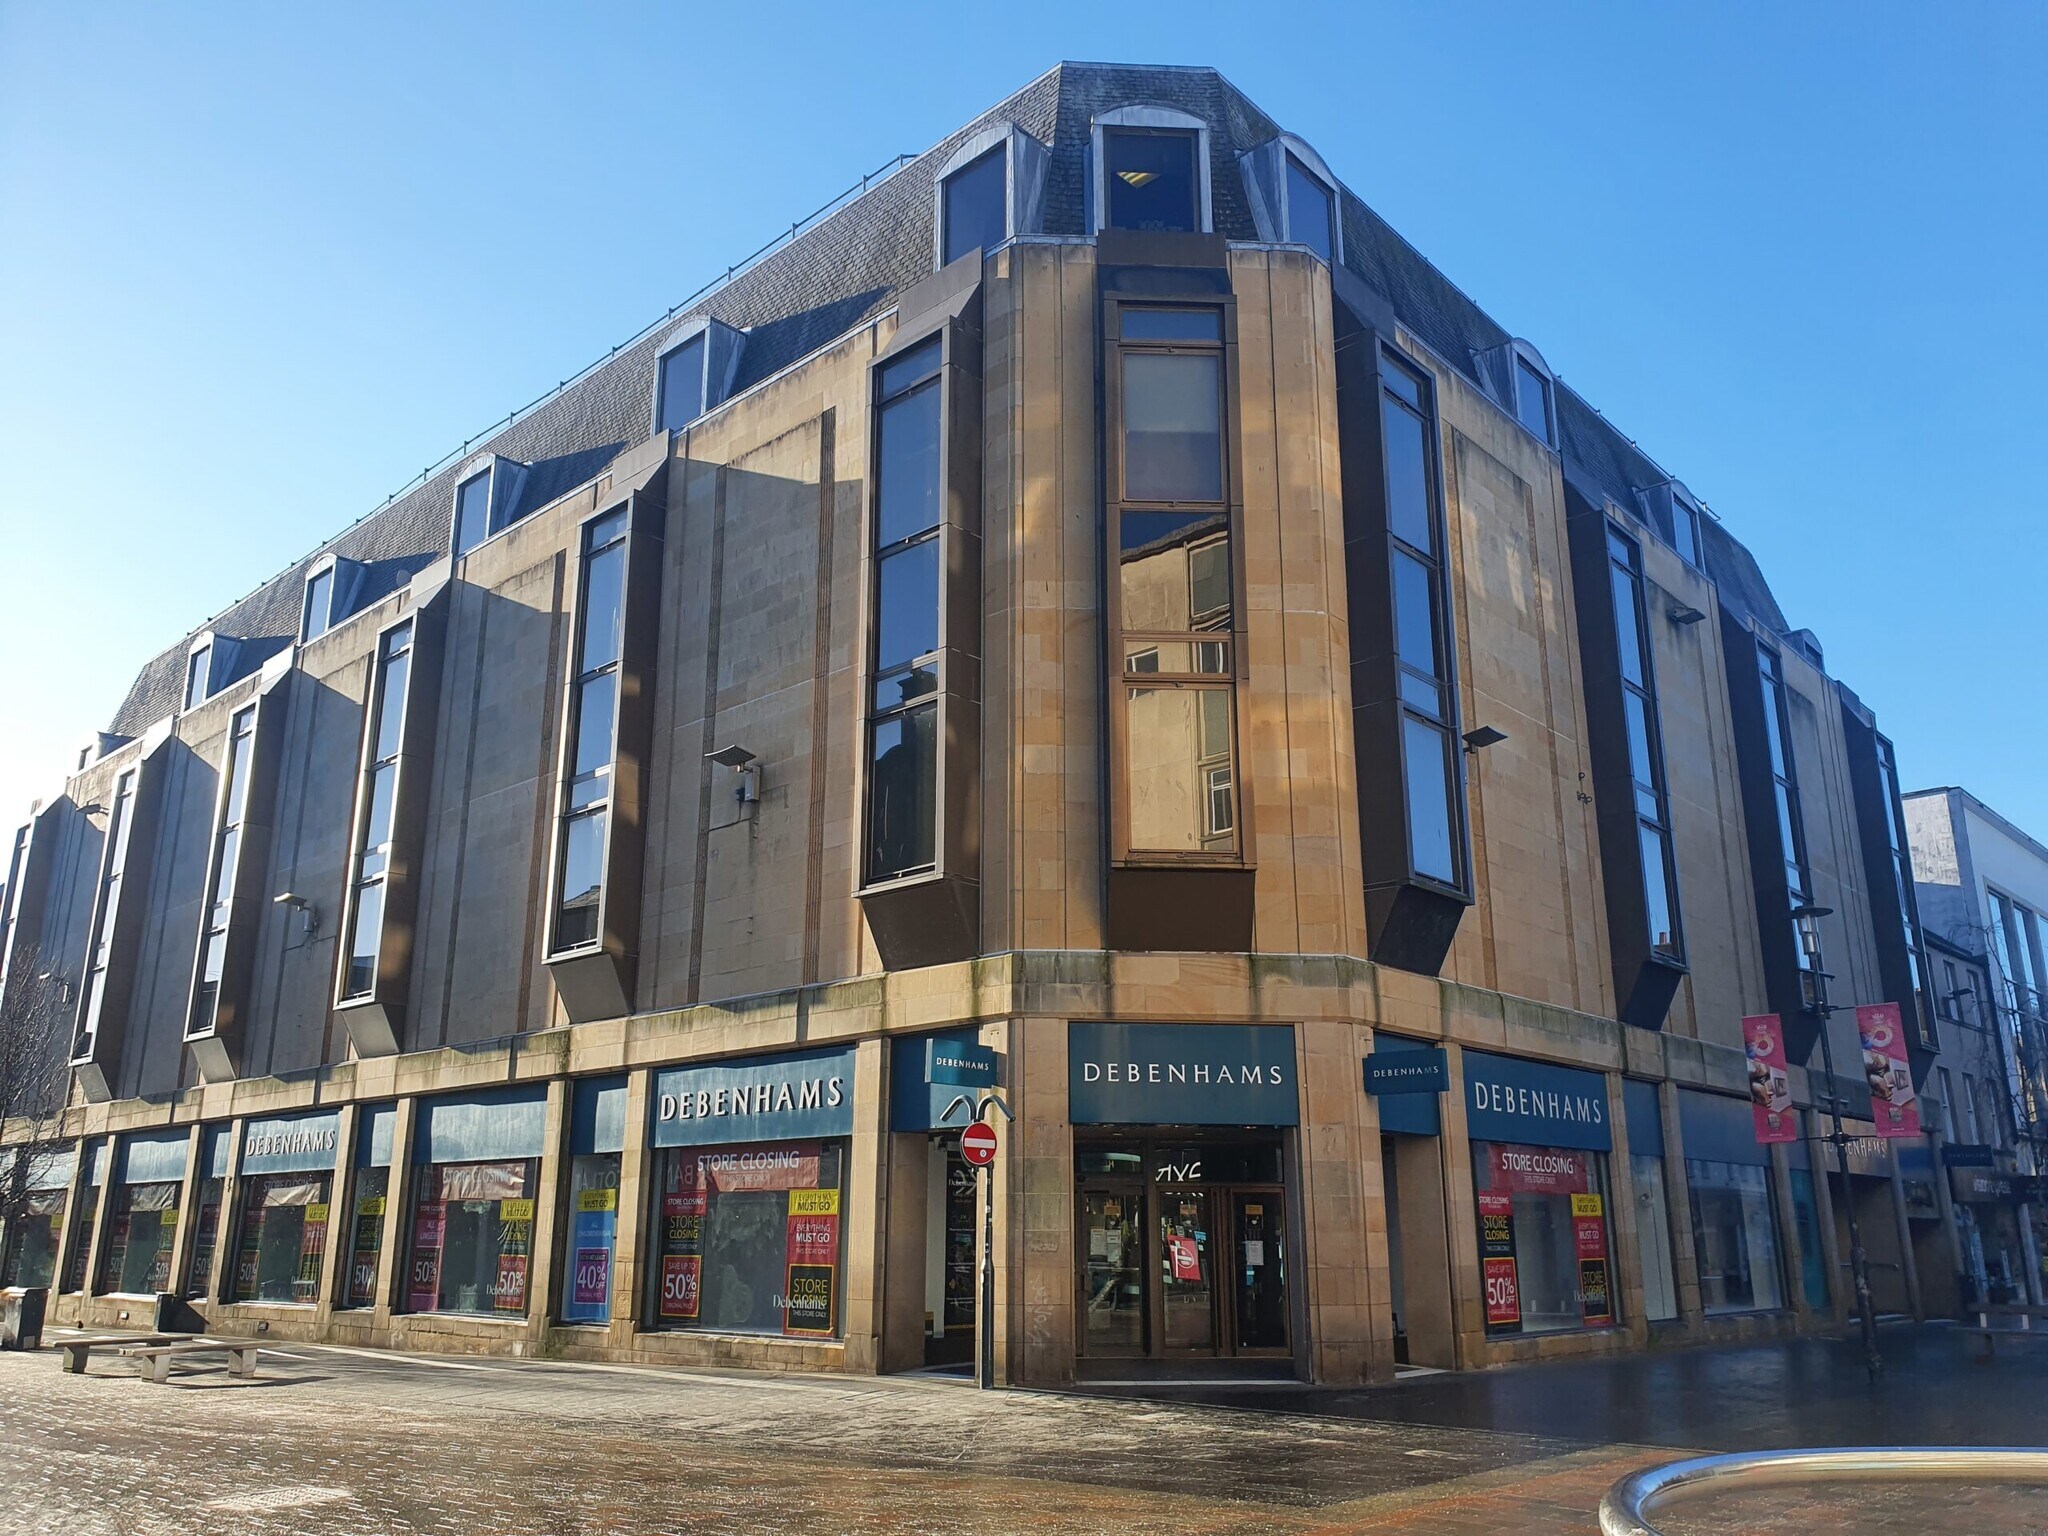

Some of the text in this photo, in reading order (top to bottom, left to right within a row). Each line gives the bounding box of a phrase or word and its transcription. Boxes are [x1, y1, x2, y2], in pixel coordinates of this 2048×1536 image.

[936, 1057, 989, 1071] DEBENHAMS
[1084, 1062, 1282, 1085] DEBENHAMS
[1374, 1065, 1439, 1078] DEBENHAMS
[660, 1076, 843, 1121] DEBENHAMS
[1475, 1082, 1601, 1124] DEBENHAMS
[247, 1129, 336, 1156] DEBENHAMS
[697, 1150, 799, 1171] STORE CLOSING
[1502, 1153, 1573, 1173] STORE CLOSING
[584, 1199, 608, 1208] MUST GO
[683, 1197, 703, 1205] CLOSING
[798, 1201, 830, 1211] MUST GO
[1478, 1196, 1491, 1204] STORE
[1577, 1204, 1597, 1212] MUST GO
[671, 1215, 699, 1229] STORE
[797, 1223, 831, 1231] EVERYTHING
[1484, 1215, 1508, 1229] STORE
[670, 1229, 698, 1239] CLOSING
[796, 1232, 830, 1242] MUST GO
[1485, 1230, 1509, 1240] CLOSING
[1579, 1230, 1600, 1239] MUST GO
[415, 1261, 437, 1282] 50%
[577, 1265, 606, 1289] 40%
[1583, 1271, 1604, 1284] STORE
[596, 1281, 605, 1289] OFF
[665, 1273, 697, 1299] 50%
[794, 1278, 828, 1294] STORE
[1488, 1277, 1514, 1305] 50%
[685, 1291, 697, 1299] OFF
[773, 1294, 827, 1309] Debenhams
[793, 1293, 828, 1306] CLOSING
[1506, 1295, 1516, 1304] OFF
